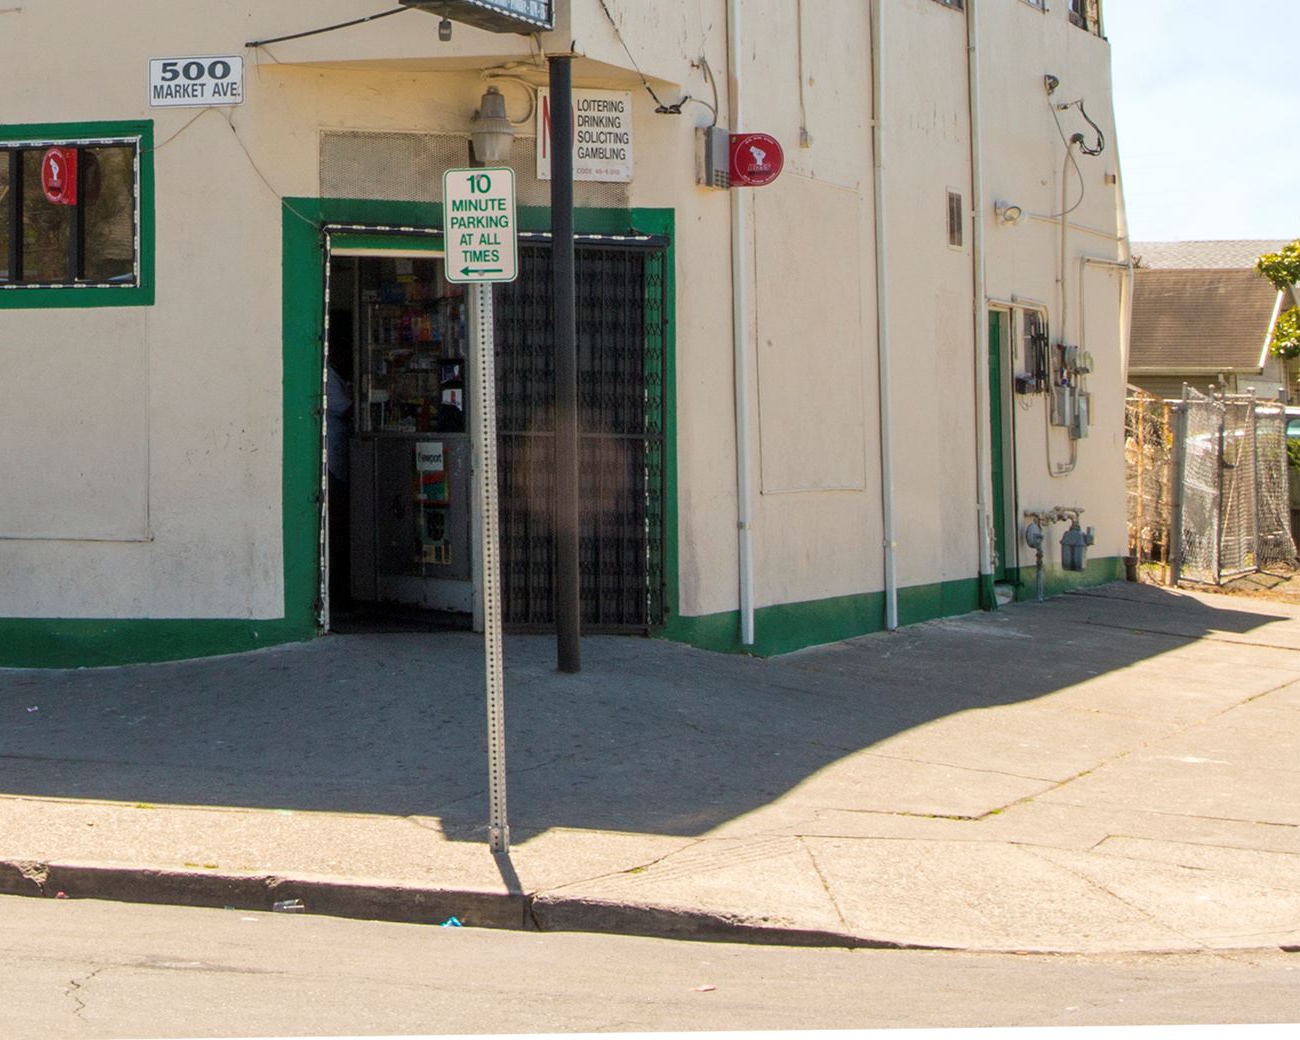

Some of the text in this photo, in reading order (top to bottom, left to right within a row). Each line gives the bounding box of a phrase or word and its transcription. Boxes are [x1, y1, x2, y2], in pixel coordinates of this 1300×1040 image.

[161, 60, 231, 81] 500
[153, 82, 240, 99] MARKET AVE.
[577, 99, 624, 113] LOITERING
[577, 115, 621, 128] DRINKING
[577, 131, 629, 144] SOLICITING
[577, 147, 626, 160] GAMBLING
[466, 174, 491, 194] 10
[452, 198, 506, 212] MINUTE
[451, 215, 509, 229] PARKING
[460, 233, 501, 246] AT ALL
[462, 249, 500, 263] TIMES
